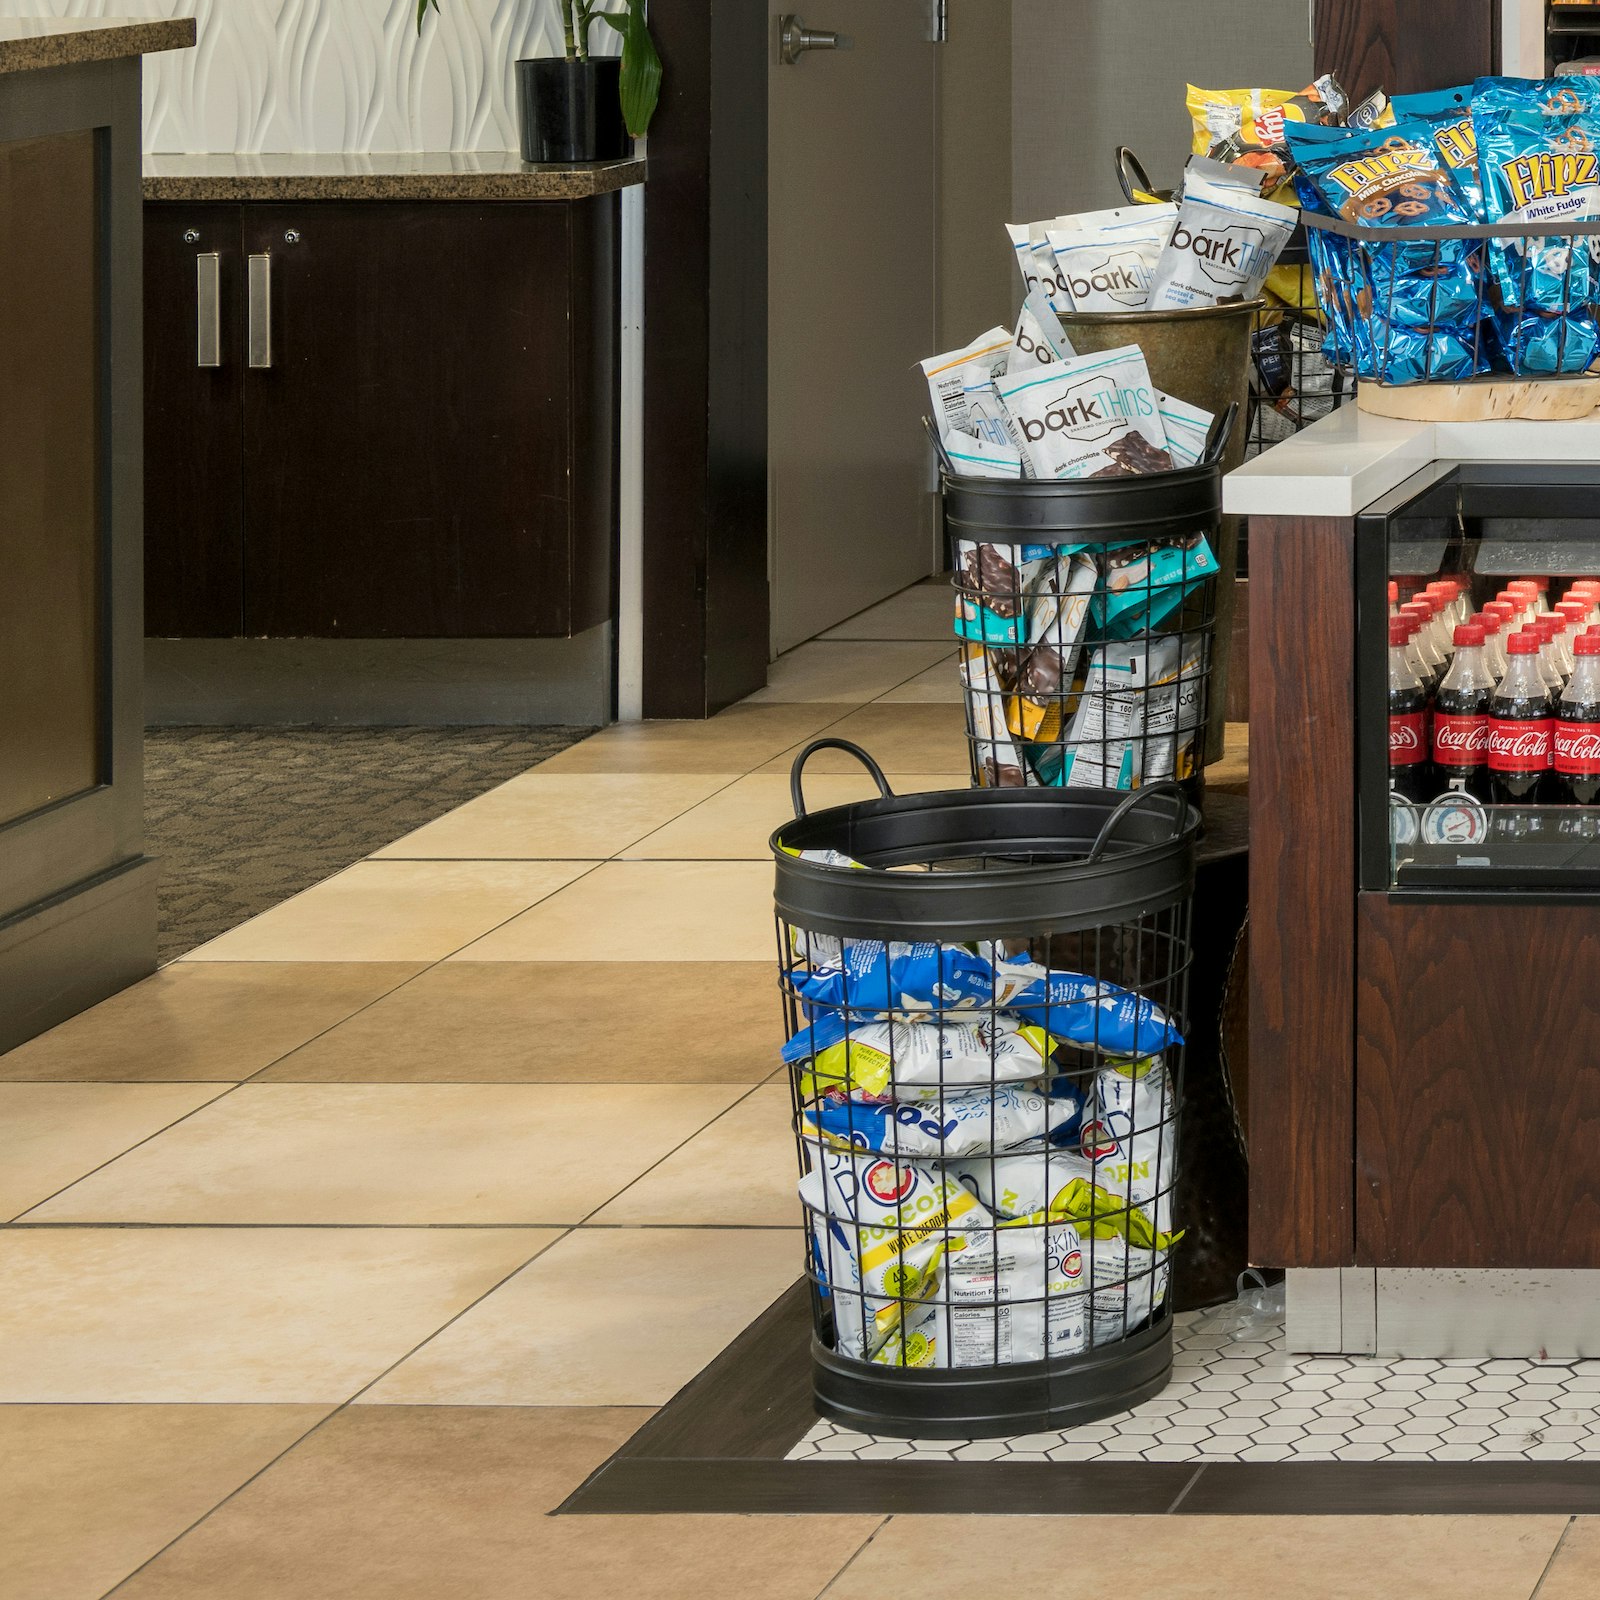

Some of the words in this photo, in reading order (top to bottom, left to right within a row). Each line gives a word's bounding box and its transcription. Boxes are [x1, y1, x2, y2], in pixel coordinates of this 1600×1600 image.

[1330, 150, 1430, 196] Flipz
[1502, 152, 1600, 211] Flipz
[1526, 206, 1552, 220] White
[1553, 196, 1586, 214] Fudge
[1170, 280, 1184, 289] dark
[1184, 285, 1213, 299] chocolate
